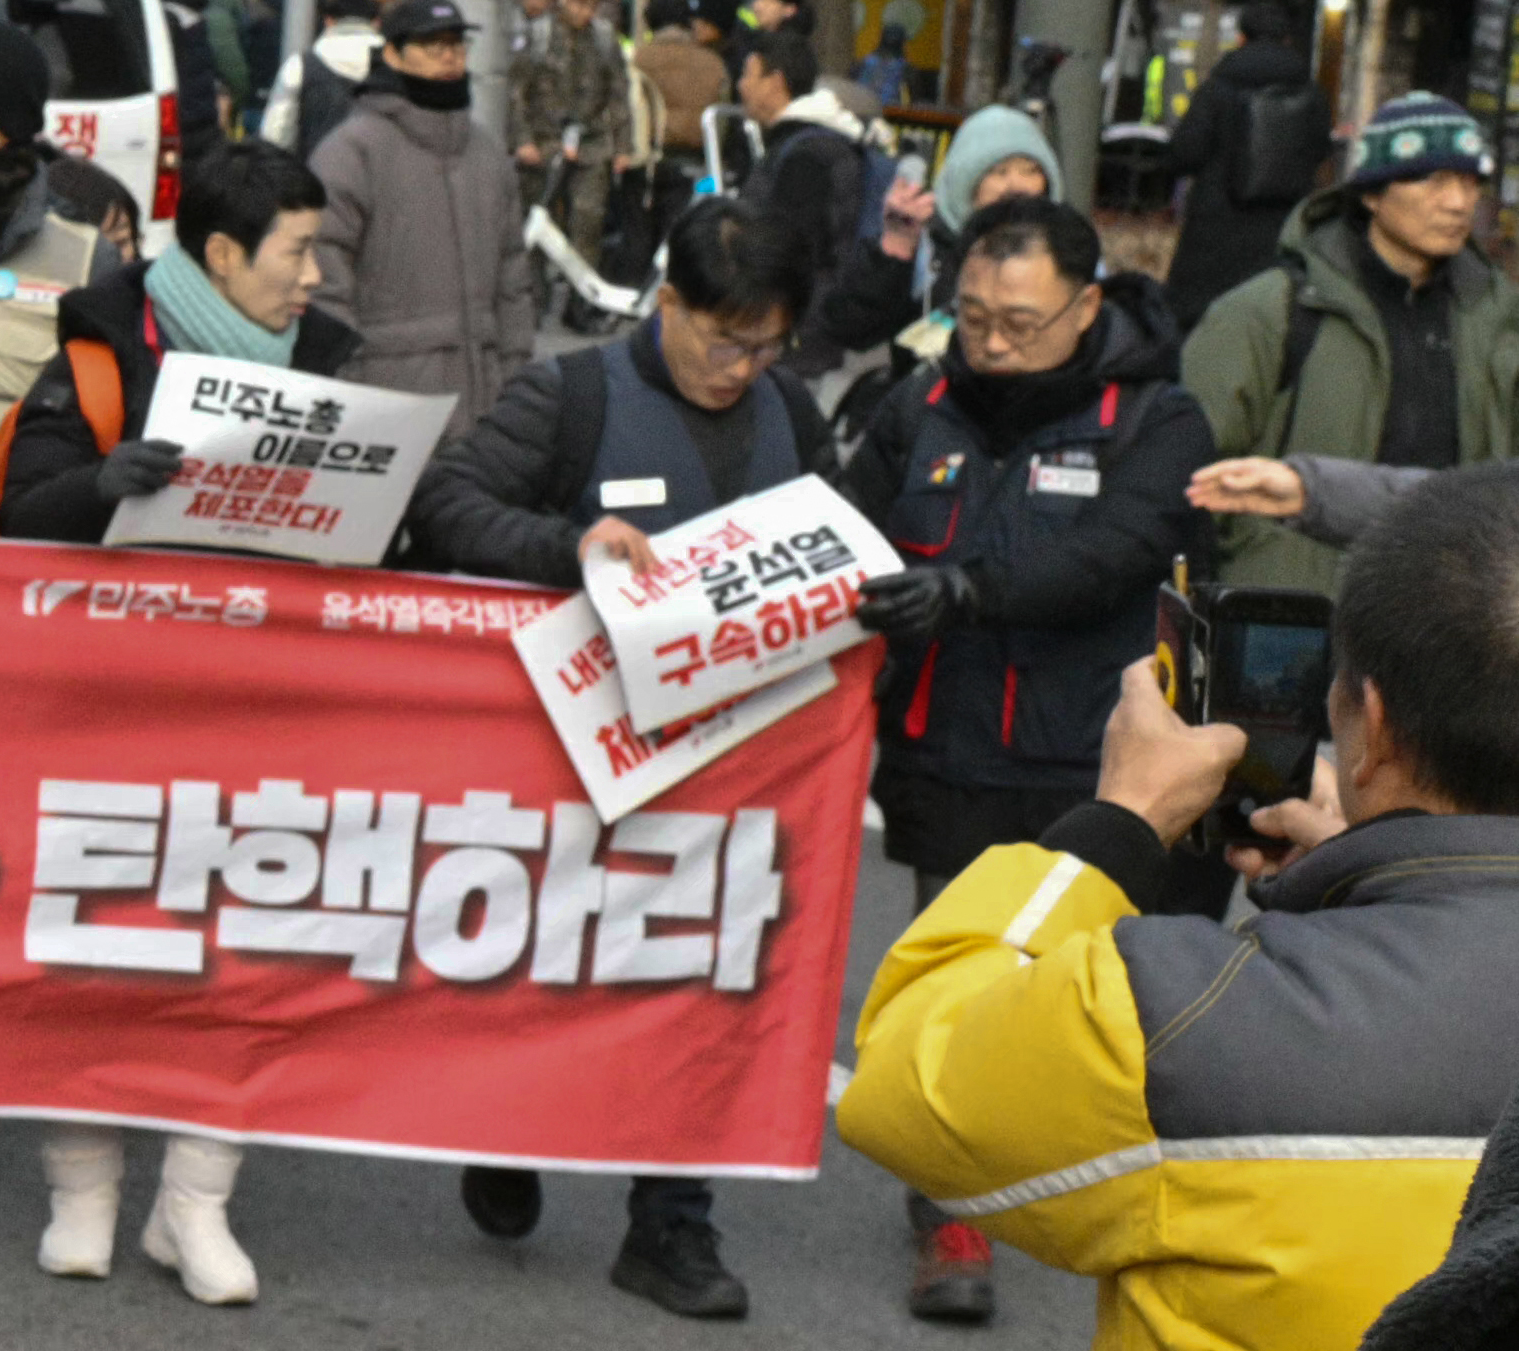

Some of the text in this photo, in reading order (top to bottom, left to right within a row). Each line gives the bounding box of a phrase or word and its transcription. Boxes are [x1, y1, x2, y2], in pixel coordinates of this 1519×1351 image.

[190, 376, 345, 435] 민주노총
[252, 433, 399, 475] 이름으로
[183, 490, 344, 534] 체포한다!
[700, 524, 859, 616] 윤석열
[87, 581, 268, 627] 민주노총
[24, 778, 780, 991] 탄핵하라
